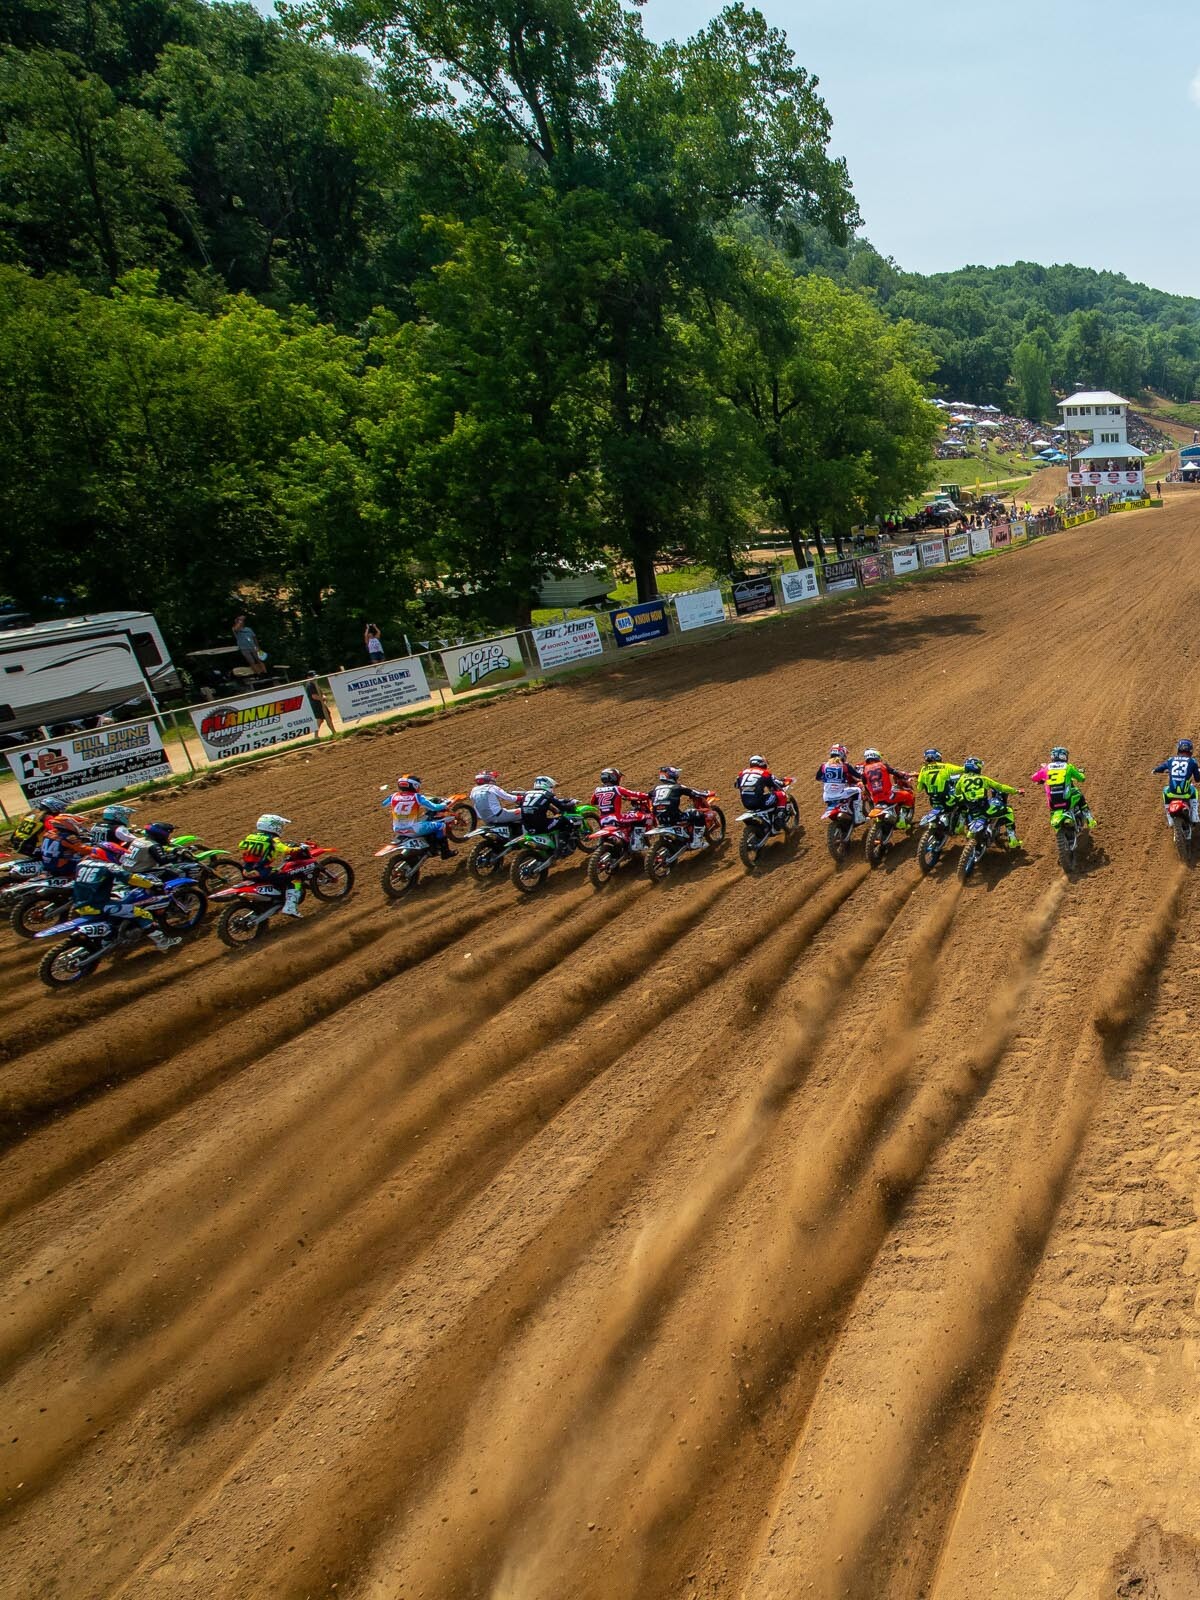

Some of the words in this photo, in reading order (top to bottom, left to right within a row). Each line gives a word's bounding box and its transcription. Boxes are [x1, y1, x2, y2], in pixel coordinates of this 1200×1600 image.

[618, 618, 633, 630] NAPA
[635, 612, 650, 626] KNOW
[651, 610, 662, 622] HOW
[578, 632, 597, 642] YAMAHA
[547, 640, 570, 650] HONDA
[459, 645, 504, 676] MOTO
[468, 656, 510, 685] TEES
[348, 675, 388, 692] AMERICAN
[388, 670, 411, 682] HOME
[201, 694, 304, 734] PLAINVIEW
[207, 714, 281, 740] POWERSPORTS
[73, 736, 104, 754] BILL
[107, 724, 150, 744] BUNE
[217, 743, 250, 760] (507)
[254, 726, 310, 750] 524-3520
[82, 736, 150, 762] ENTERPRISES
[90, 747, 152, 766] www.billbune.com
[1172, 761, 1188, 776] 23
[27, 776, 60, 790] Cylinder
[740, 773, 762, 786] 15
[928, 770, 939, 785] 7
[964, 777, 983, 792] 29
[1046, 769, 1067, 786] 3
[34, 778, 78, 796] Crankshaft
[595, 792, 615, 806] 72
[655, 788, 671, 802] 19
[394, 801, 416, 815] 43
[20, 865, 36, 874] 483
[86, 926, 104, 936] 916
